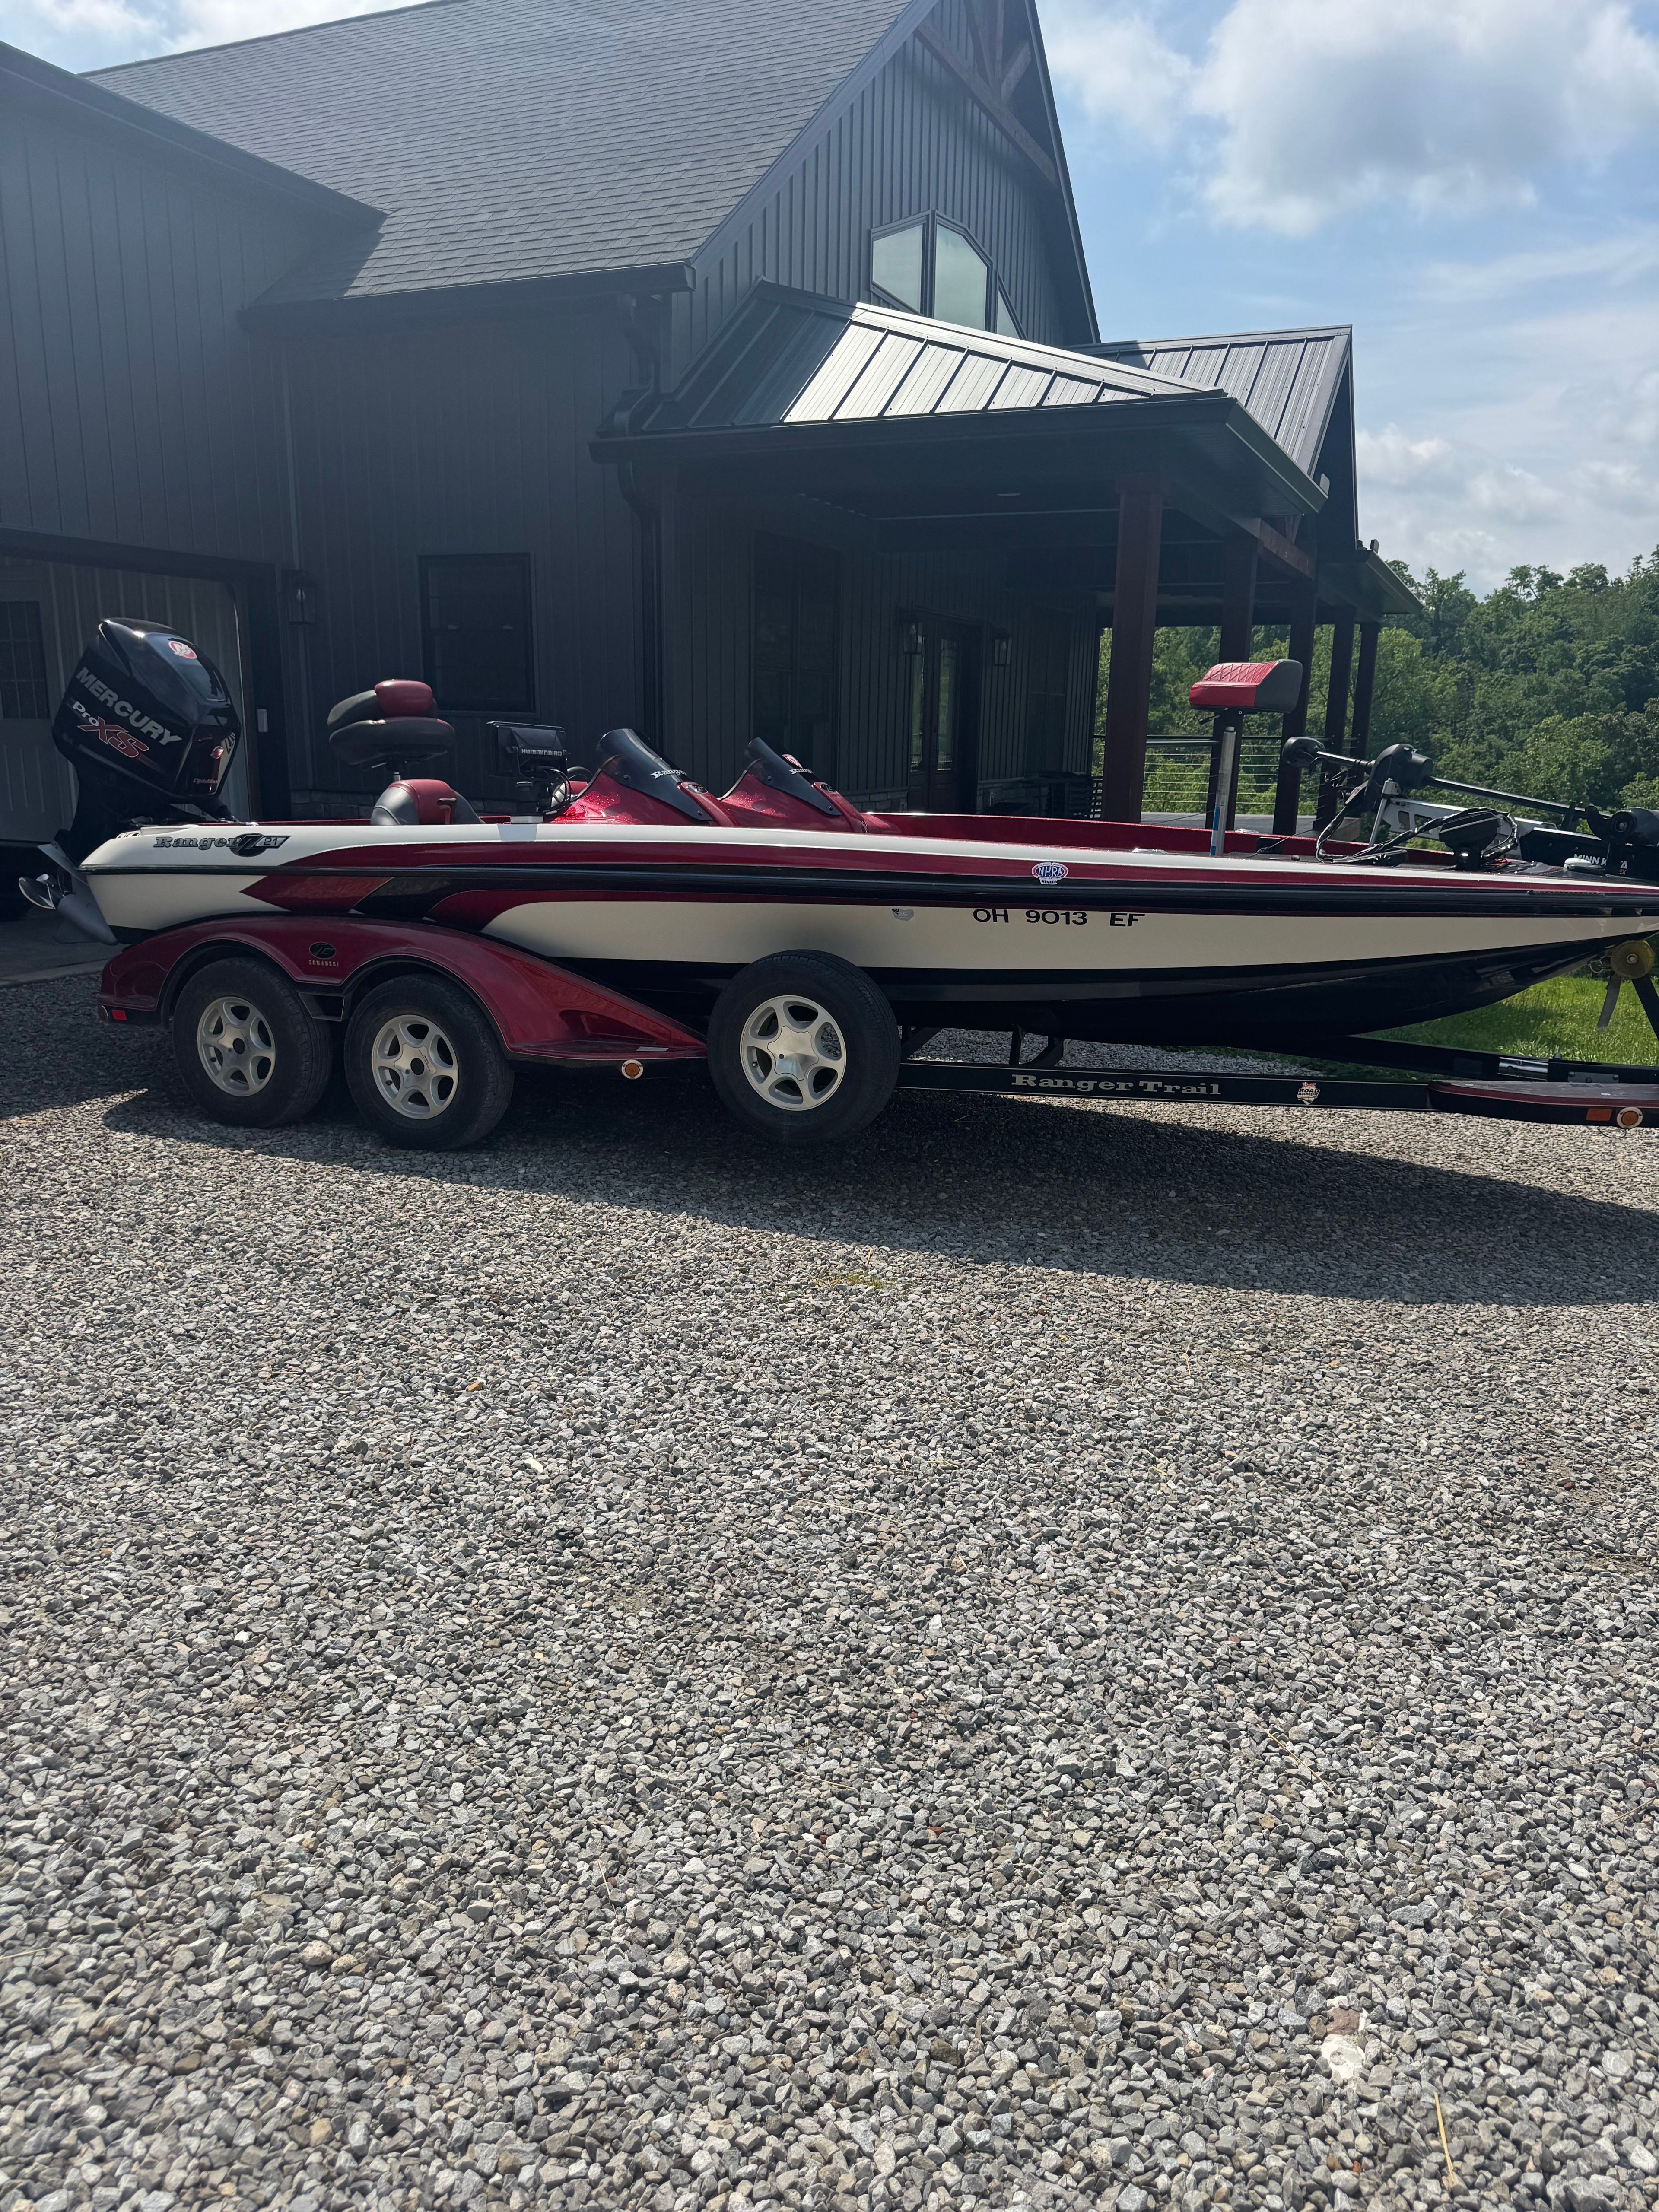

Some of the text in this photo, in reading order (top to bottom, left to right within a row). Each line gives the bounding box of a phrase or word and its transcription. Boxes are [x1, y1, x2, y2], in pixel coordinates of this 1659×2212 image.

[76, 667, 182, 745] MERCURY
[73, 701, 149, 758] Pro XS
[153, 836, 242, 850] Ranger
[1038, 866, 1062, 877] NHRA
[973, 909, 1145, 927] OH 9013 EF
[1011, 1074, 1221, 1095] Ranger Trail
